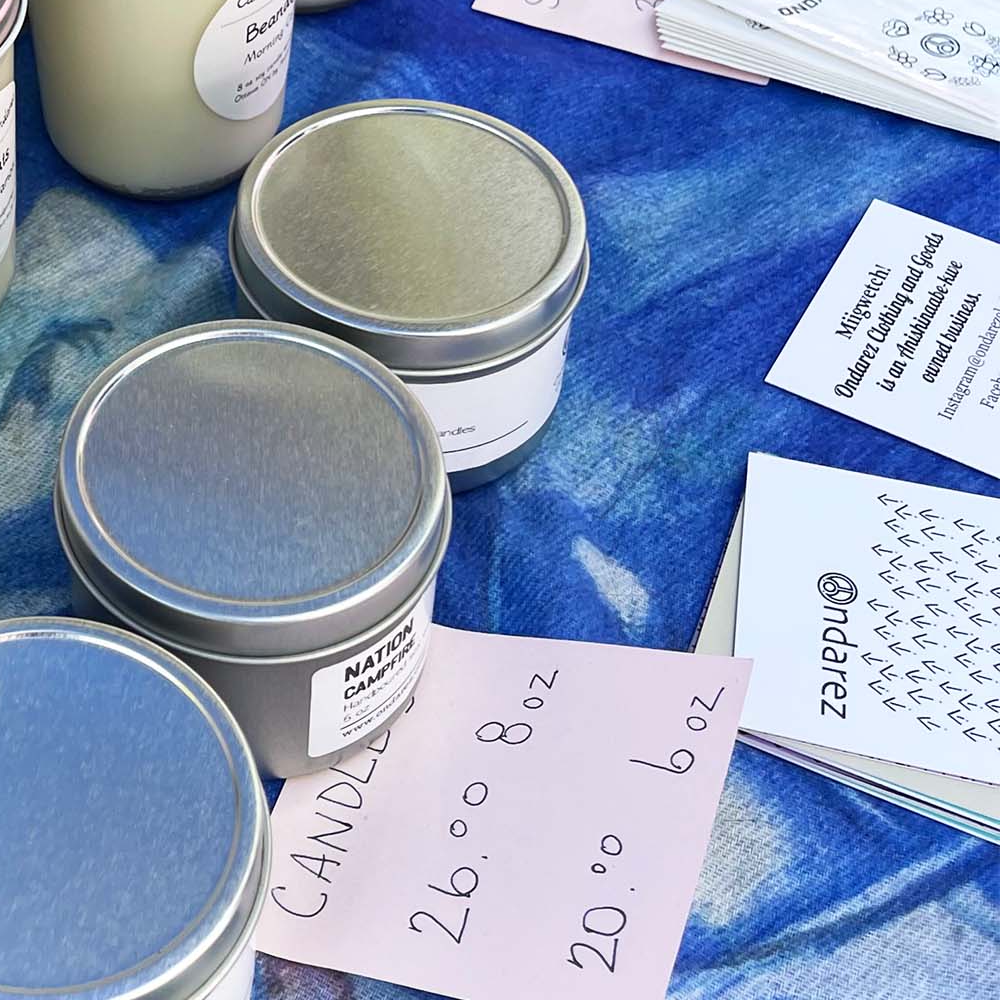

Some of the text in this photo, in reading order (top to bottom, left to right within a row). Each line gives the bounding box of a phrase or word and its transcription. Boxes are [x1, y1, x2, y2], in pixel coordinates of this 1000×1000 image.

[834, 232, 944, 398] Ondarez Clothing and Goods
[835, 264, 892, 340] Miigwetch!
[922, 293, 982, 383] owned business.
[876, 377, 895, 392] is
[890, 360, 907, 379] an
[344, 617, 414, 682] NATION
[344, 632, 417, 700] CAMPFIRE
